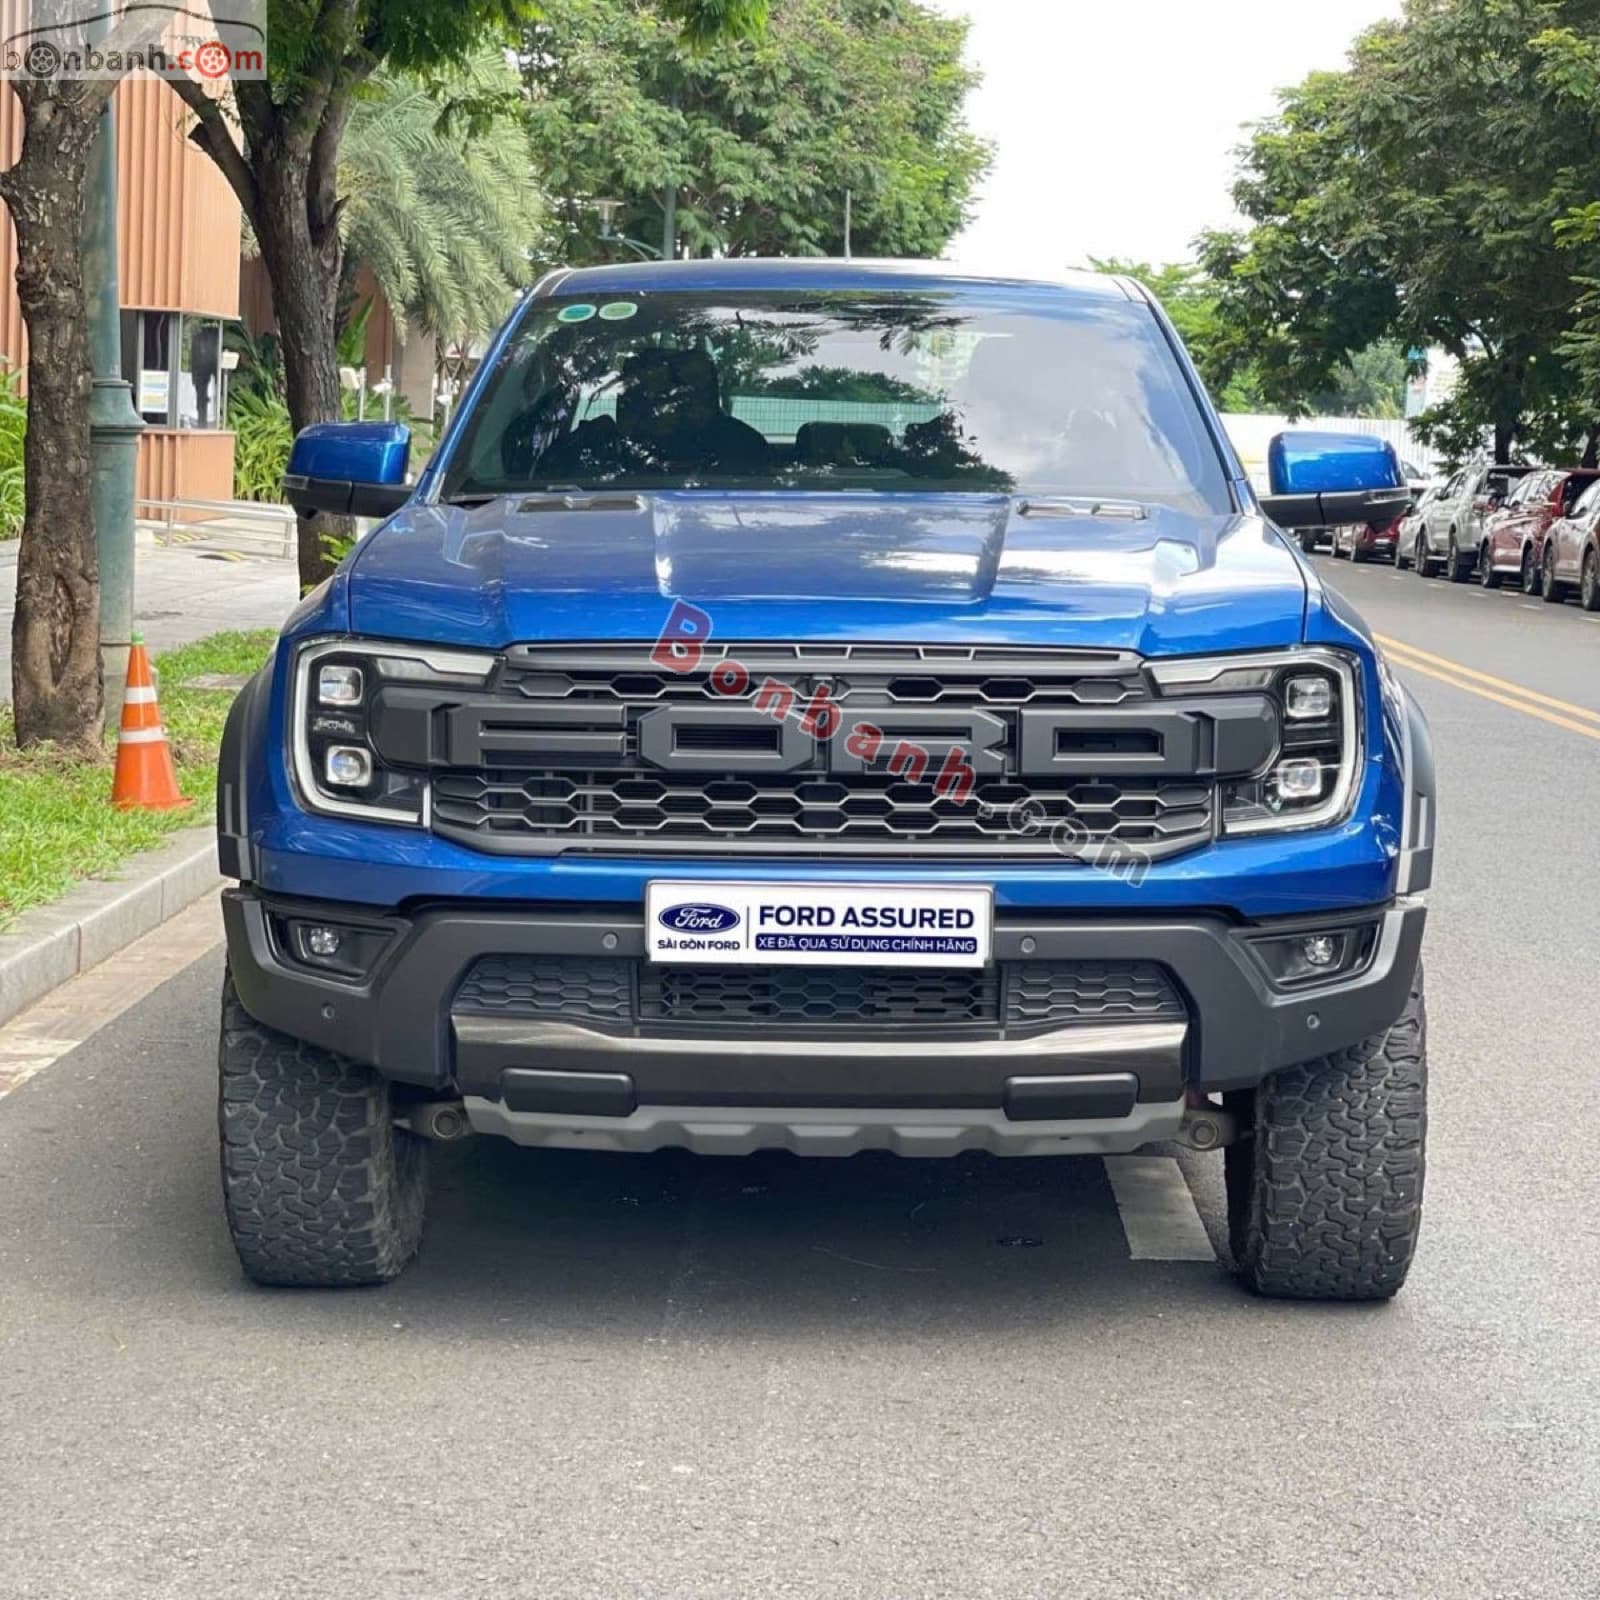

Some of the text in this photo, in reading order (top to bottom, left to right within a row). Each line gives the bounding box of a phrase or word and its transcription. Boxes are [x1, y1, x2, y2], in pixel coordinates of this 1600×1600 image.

[450, 703, 1200, 776] FORD
[674, 907, 724, 928] Ford
[759, 905, 974, 928] FORD ASSURED
[657, 937, 740, 950] SÀI GÒN FORD
[759, 936, 776, 948] XE
[777, 935, 797, 949] ĐÃ
[799, 938, 828, 952] QUA
[851, 938, 890, 953] DỤNG
[891, 937, 934, 950] CHÍNH
